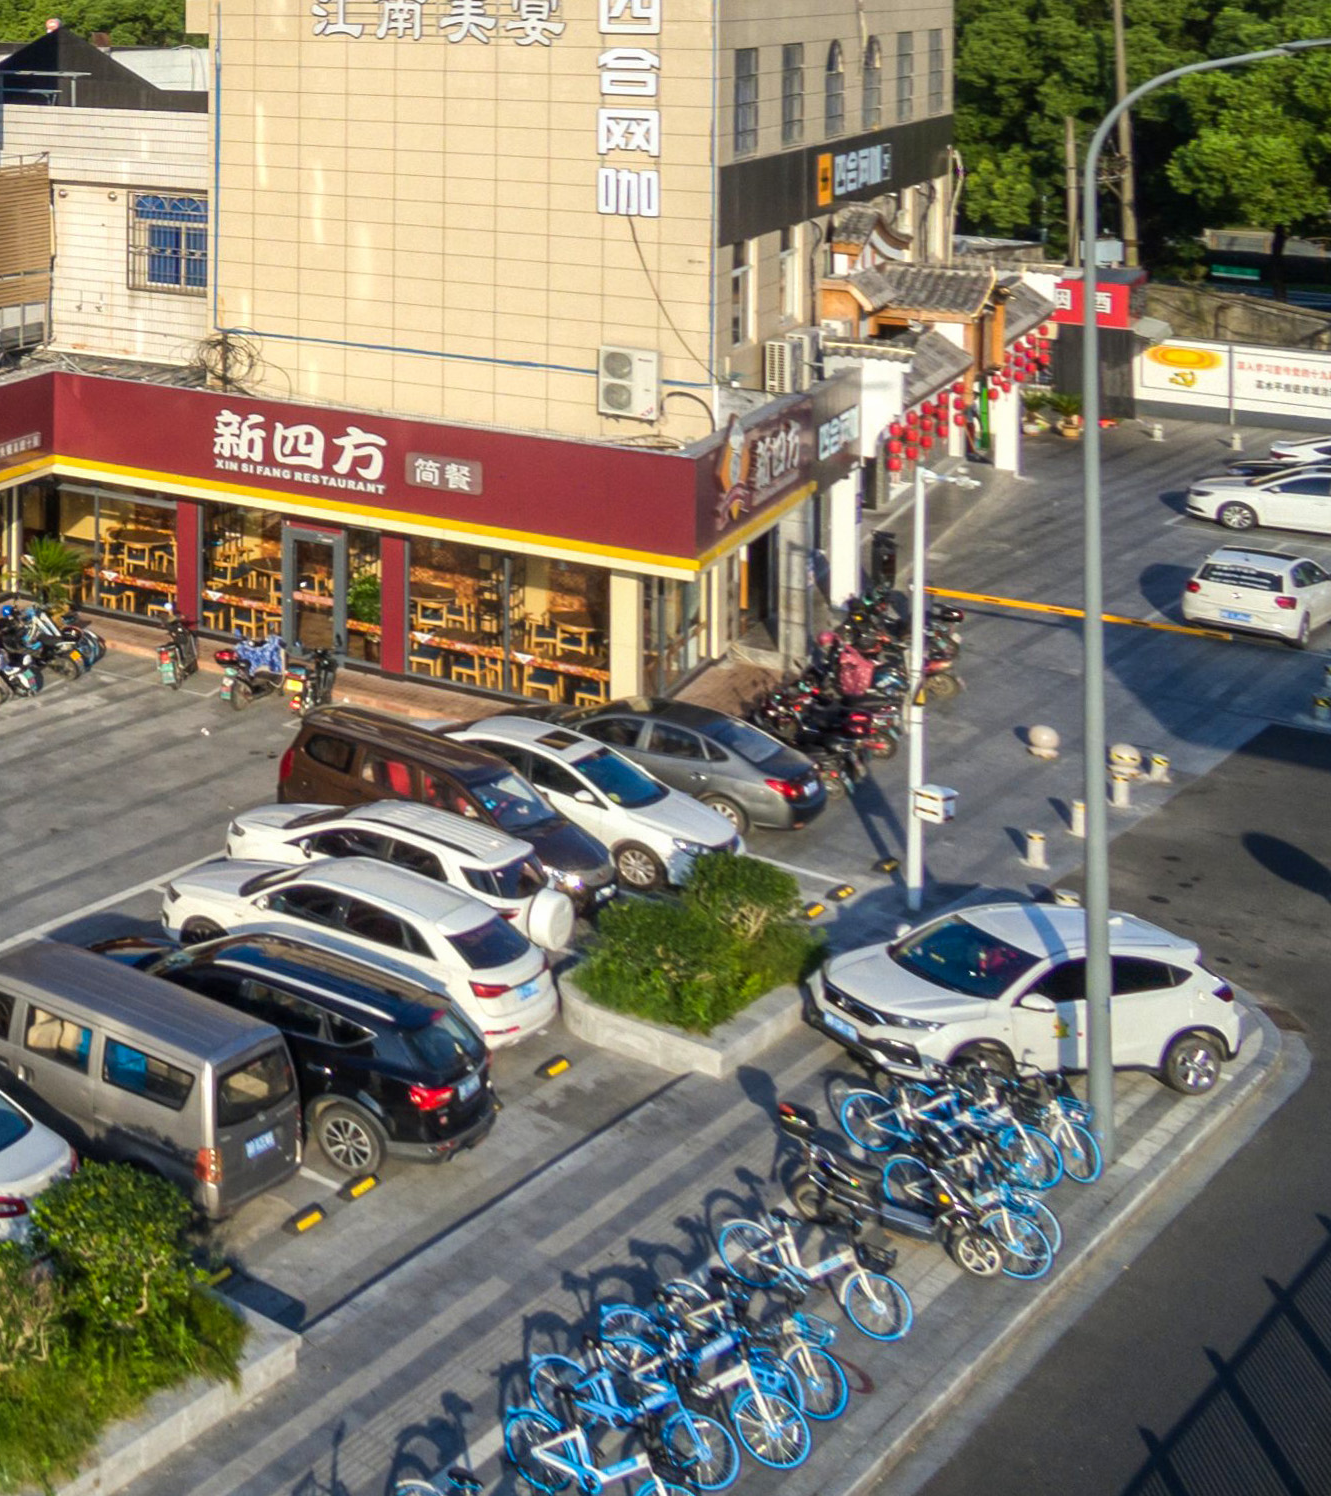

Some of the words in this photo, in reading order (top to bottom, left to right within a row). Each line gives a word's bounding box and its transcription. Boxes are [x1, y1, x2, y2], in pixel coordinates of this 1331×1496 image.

[213, 409, 387, 481] 新四方
[215, 459, 238, 472] XIN
[240, 461, 254, 473] SI
[256, 465, 291, 480] FANG
[294, 470, 386, 495] RESTAURANT
[414, 458, 472, 491] 简餐
